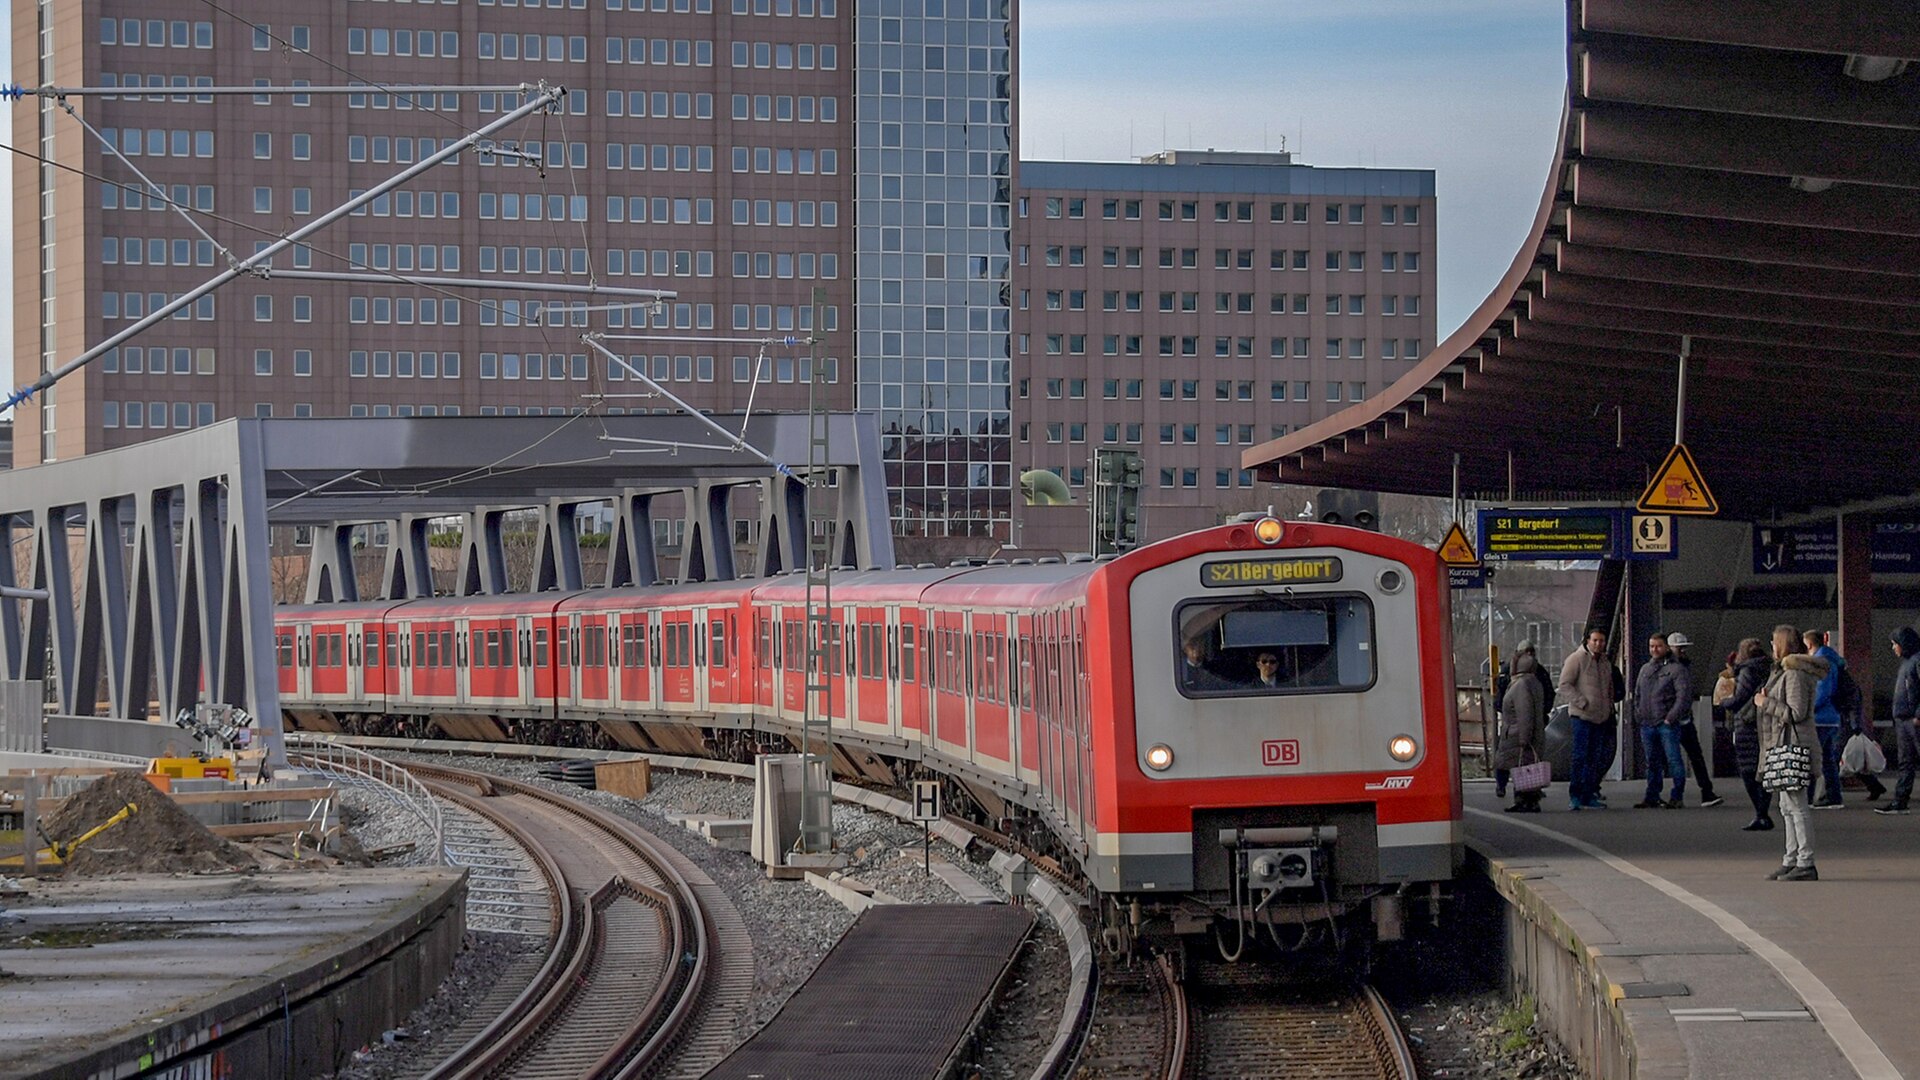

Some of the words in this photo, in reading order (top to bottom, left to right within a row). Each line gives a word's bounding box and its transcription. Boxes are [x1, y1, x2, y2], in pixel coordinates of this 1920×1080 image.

[1496, 519, 1512, 529] S21
[1518, 518, 1560, 530] Bergedorf
[1875, 552, 1911, 562] Hamburg
[1211, 563, 1239, 581] S21
[1241, 559, 1332, 581] Bergedorf
[1449, 568, 1480, 578] Kurzzug
[1450, 577, 1469, 585] Ende
[1265, 743, 1297, 763] DB
[1387, 778, 1413, 789] HVV
